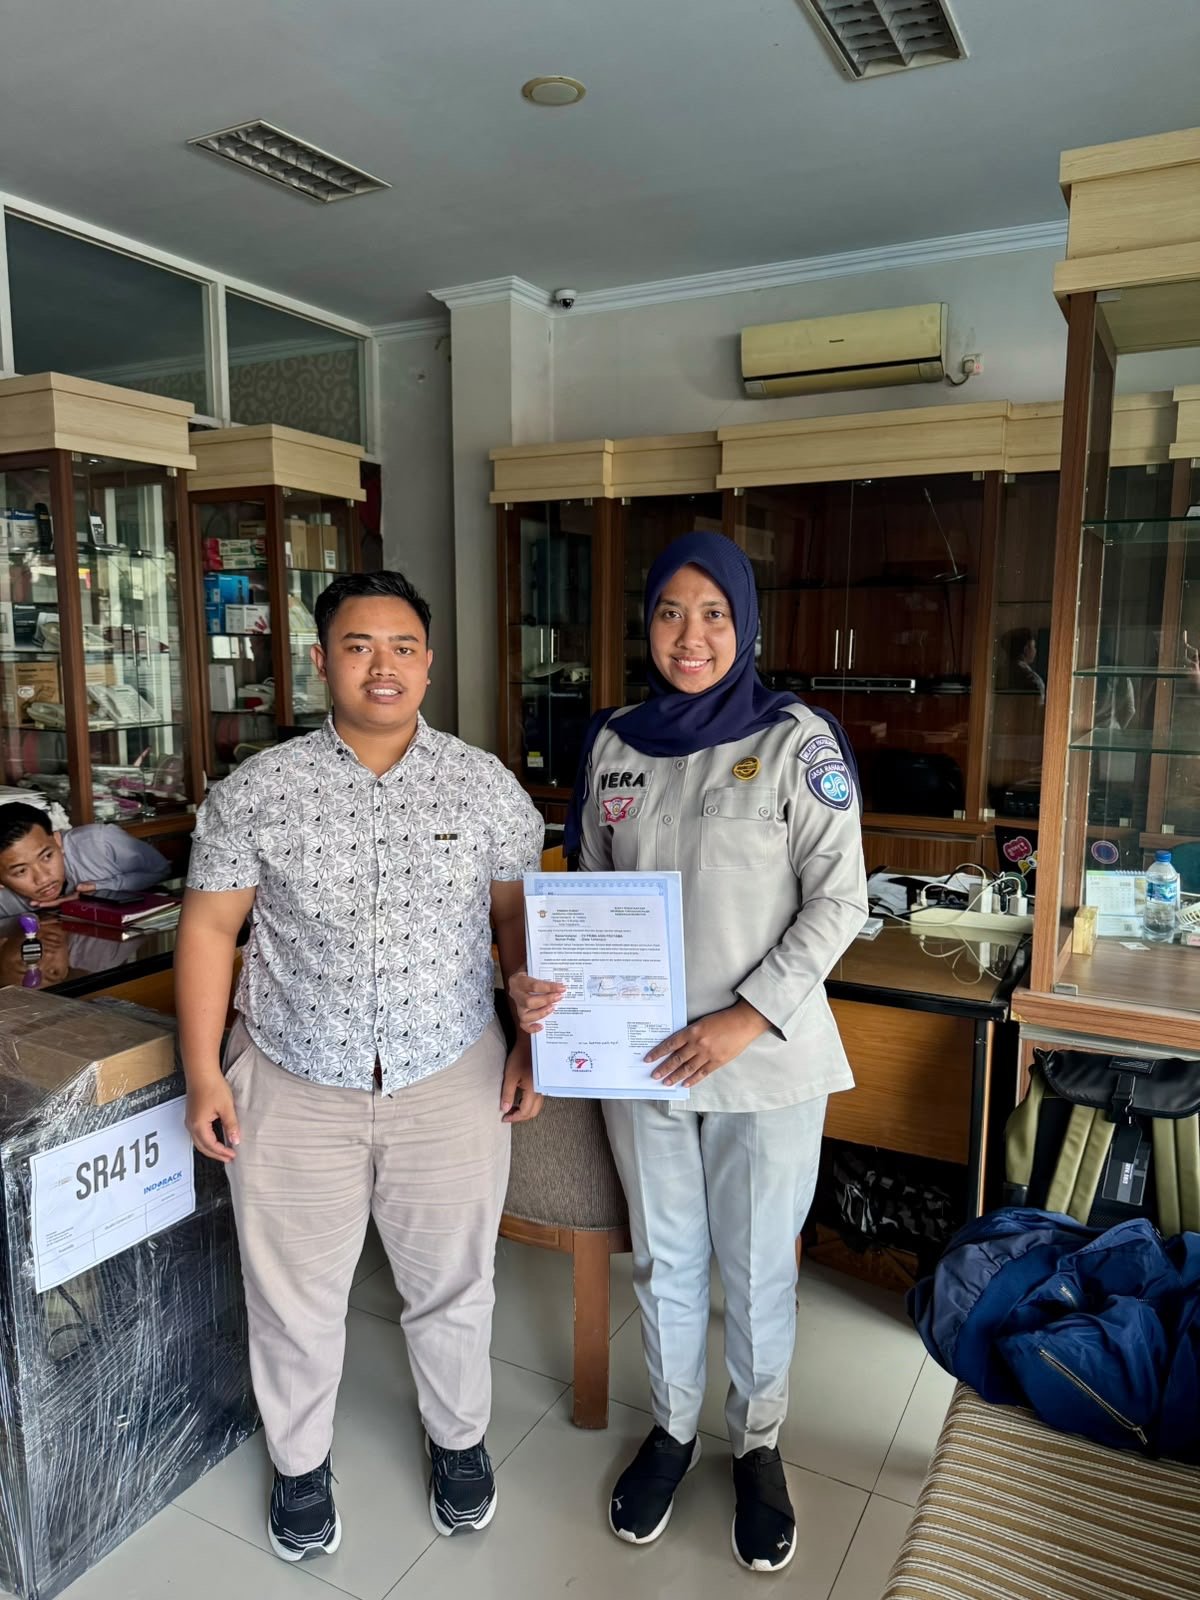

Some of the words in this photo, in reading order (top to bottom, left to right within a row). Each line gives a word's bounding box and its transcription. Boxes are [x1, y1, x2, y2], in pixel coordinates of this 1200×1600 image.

[601, 771, 646, 791] VERA
[811, 767, 825, 780] JASA
[76, 1131, 159, 1200] SR415
